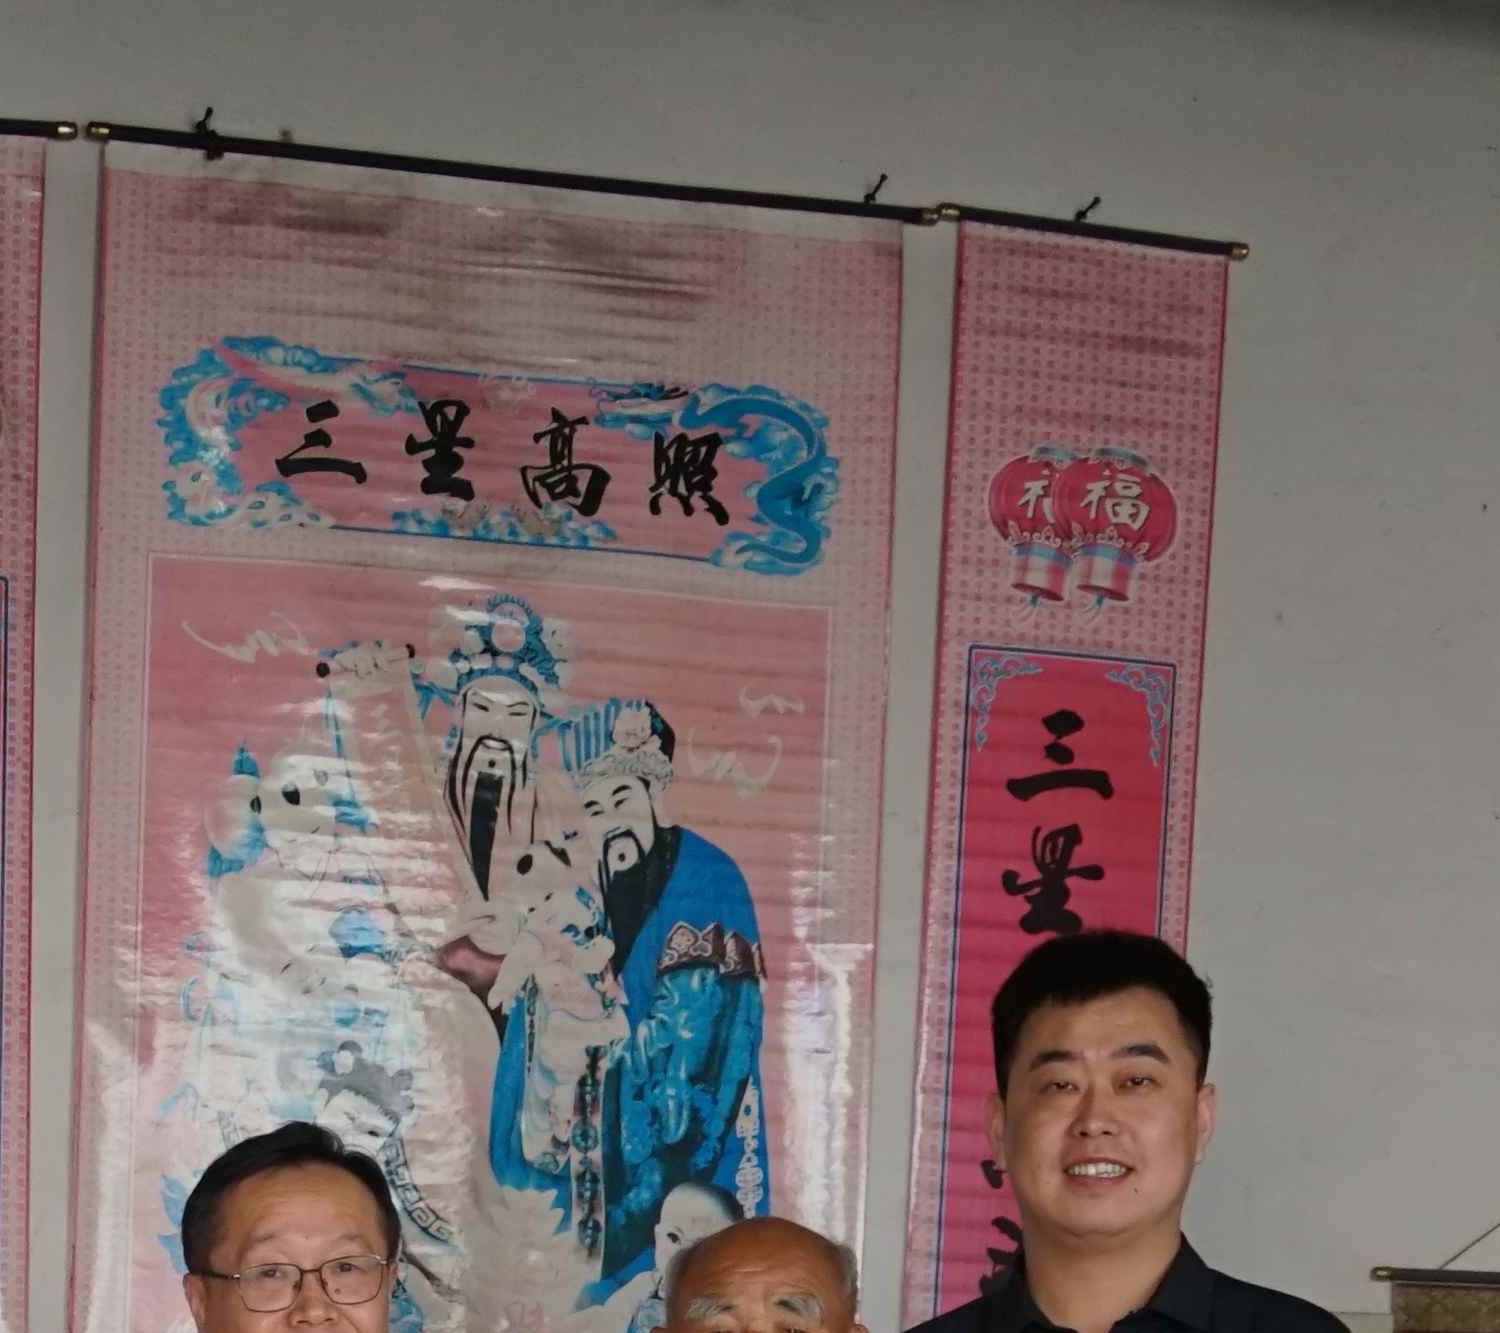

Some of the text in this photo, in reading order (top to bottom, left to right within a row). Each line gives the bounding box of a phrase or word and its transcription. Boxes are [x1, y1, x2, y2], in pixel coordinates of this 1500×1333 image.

[274, 400, 730, 527] 三星高照
[1079, 468, 1151, 532] 福
